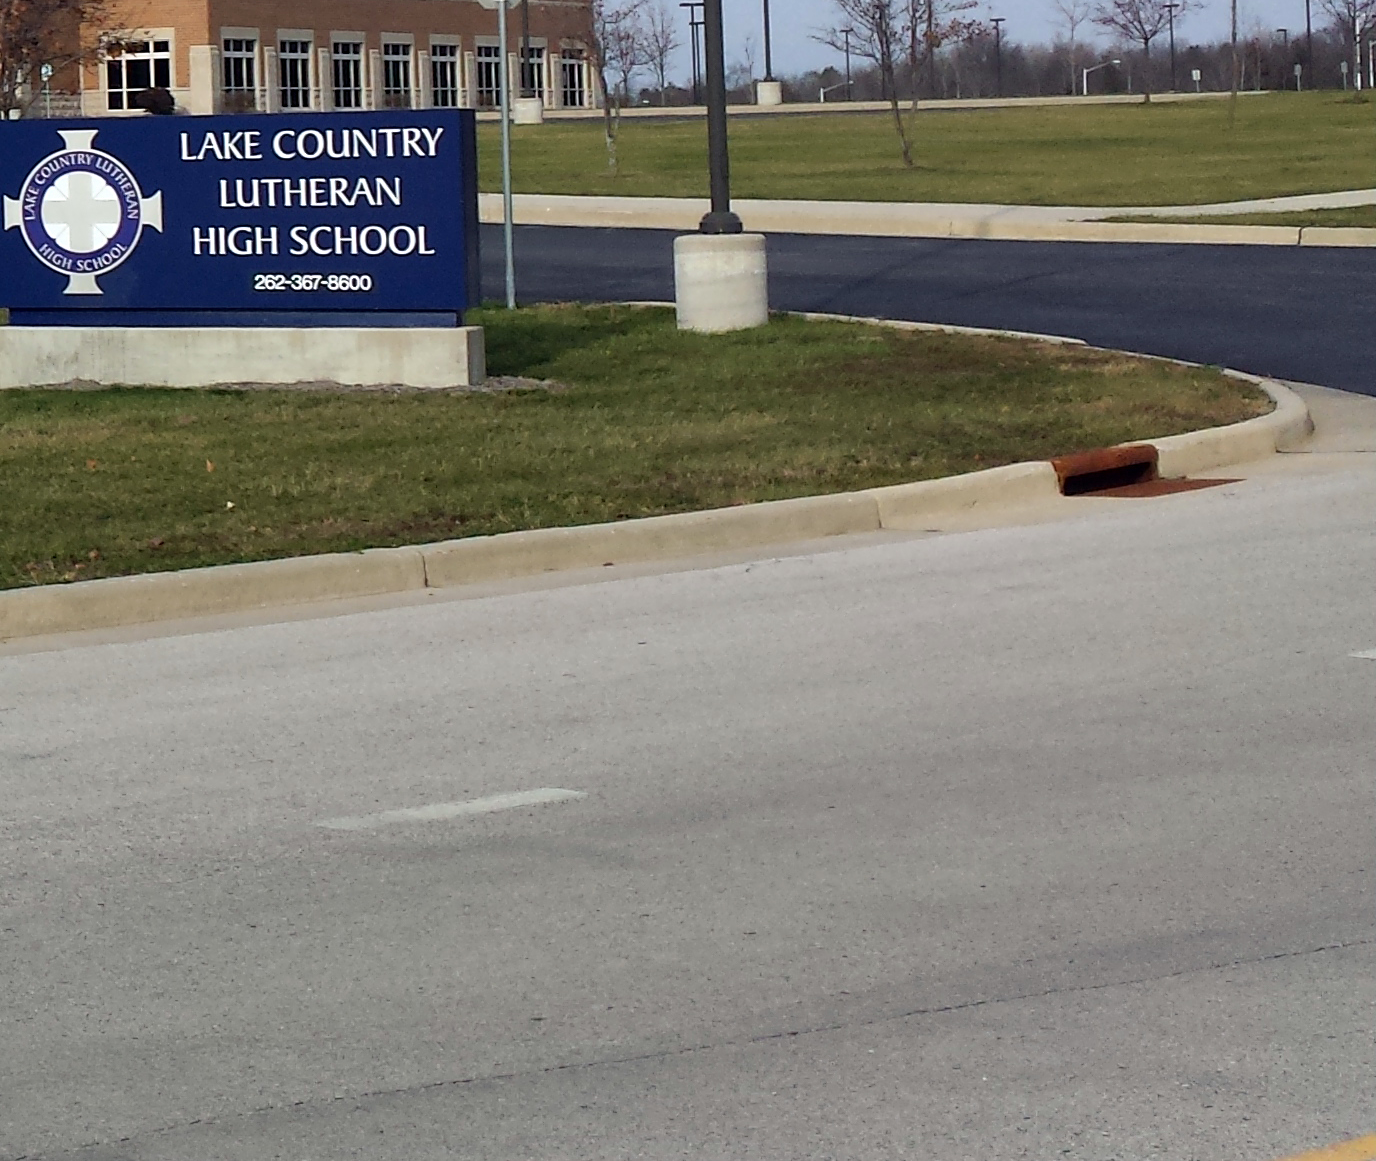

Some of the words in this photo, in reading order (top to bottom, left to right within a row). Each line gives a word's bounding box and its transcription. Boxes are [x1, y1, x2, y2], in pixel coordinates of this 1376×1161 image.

[180, 131, 263, 160] LAKE
[273, 127, 444, 159] COUNTRY
[24, 184, 40, 221] LAKE
[34, 153, 94, 185] COUNTRY
[95, 157, 139, 220] LUTHERAN
[220, 177, 401, 208] LUTHERAN
[193, 226, 278, 255] HIGH
[289, 225, 436, 255] SCHOOL
[38, 243, 73, 270] HIGH
[76, 243, 128, 271] SCHOOL
[254, 274, 372, 292] 262-367-8600
